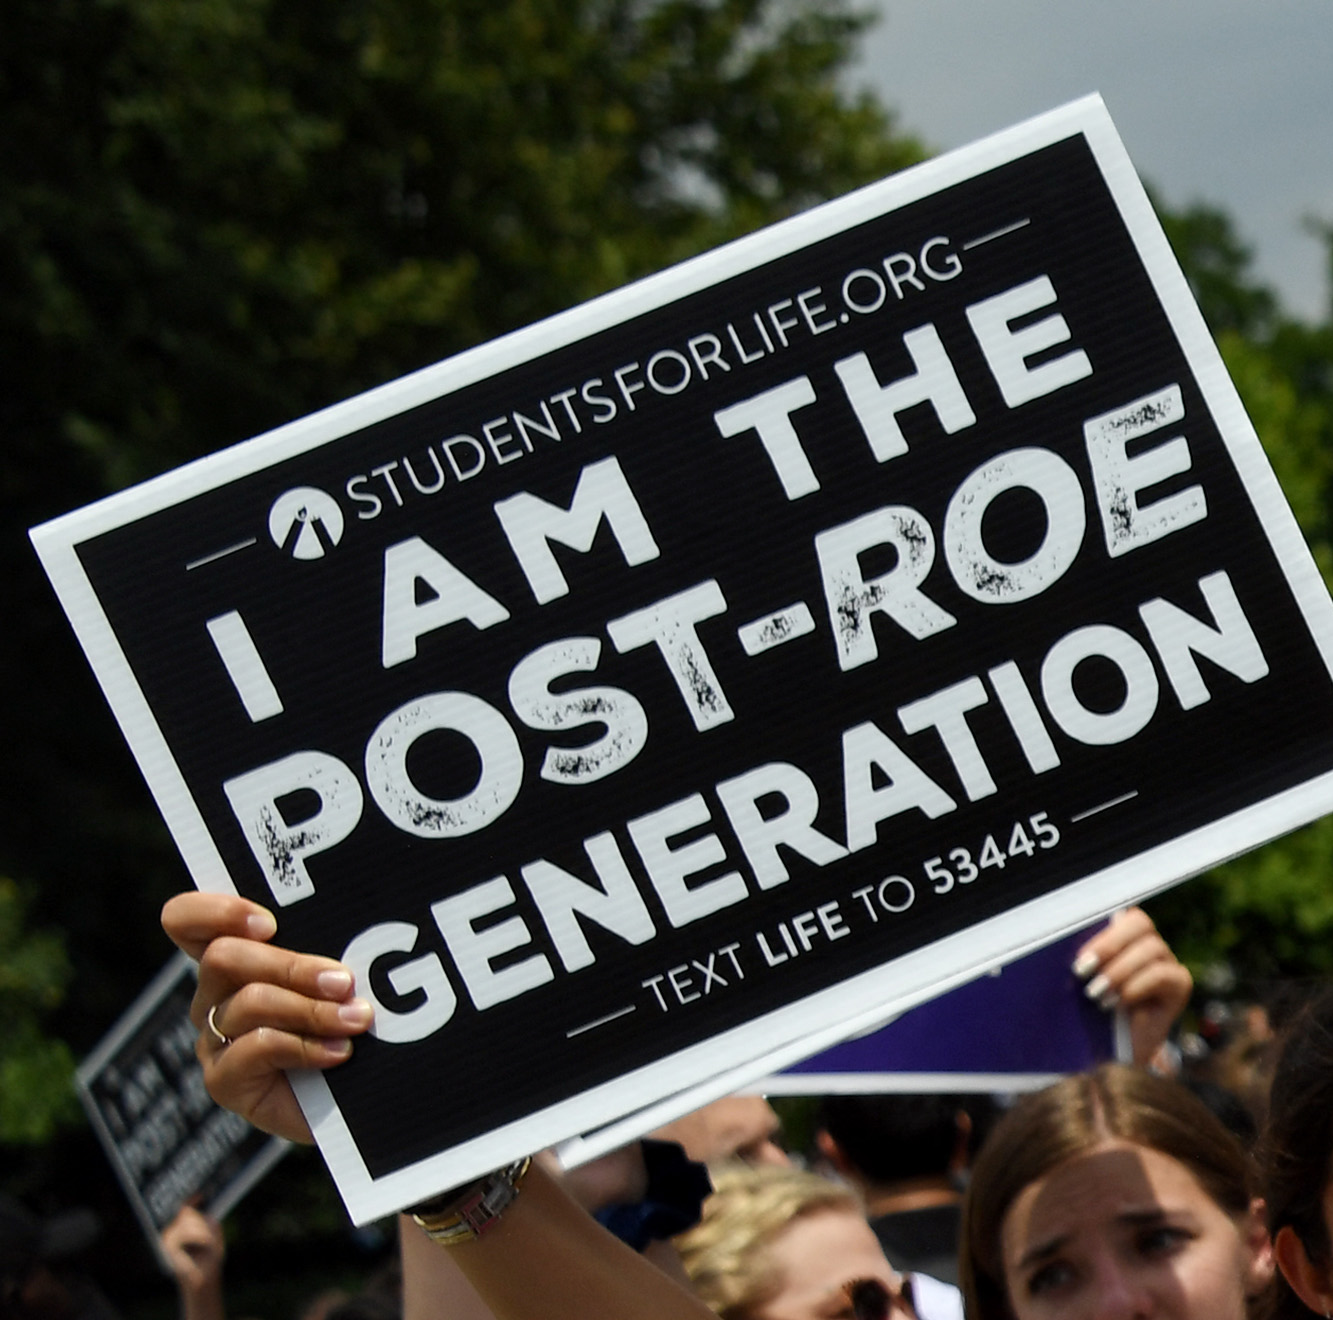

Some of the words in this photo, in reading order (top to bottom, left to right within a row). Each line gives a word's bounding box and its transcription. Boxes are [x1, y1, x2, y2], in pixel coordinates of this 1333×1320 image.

[207, 611, 283, 722] I
[383, 457, 660, 668] AM
[714, 275, 1092, 500] THE
[347, 238, 962, 518] STUDENTSFORLIFE.ORG
[224, 384, 1207, 906] POST-ROE
[341, 571, 1269, 1043] GENERATION
[643, 944, 743, 1011] TEXT
[757, 902, 850, 966] LIFE
[853, 877, 914, 921] TO
[924, 813, 1059, 893] 53445
